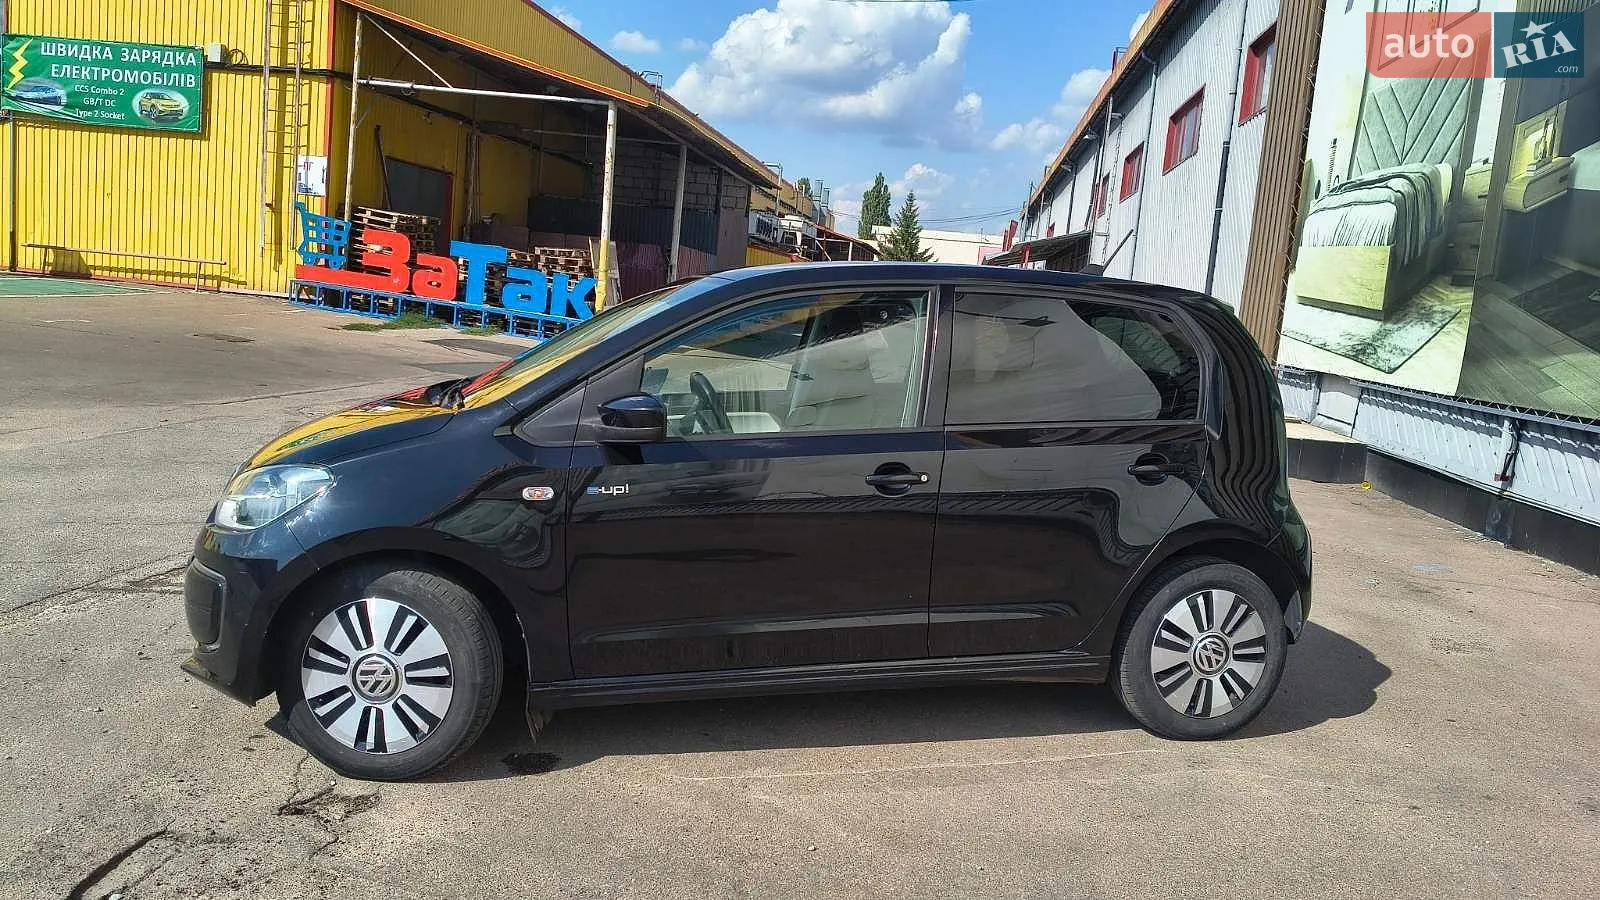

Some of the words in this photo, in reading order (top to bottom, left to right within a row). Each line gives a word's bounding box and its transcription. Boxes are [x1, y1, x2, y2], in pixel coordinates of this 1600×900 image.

[40, 42, 113, 61] ШВИДКА
[120, 47, 197, 67] ЗАРЯДКА
[51, 64, 196, 88] ЕЛЕКТРОМОБІЛІВ
[74, 84, 89, 93] CCS
[91, 86, 118, 95] Combo
[119, 88, 125, 96] 2
[83, 97, 103, 107] GB/T
[104, 99, 117, 107] DC
[75, 108, 93, 119] Type
[94, 110, 99, 118] 2
[100, 110, 126, 120] Socket
[585, 483, 630, 496] e-up!
